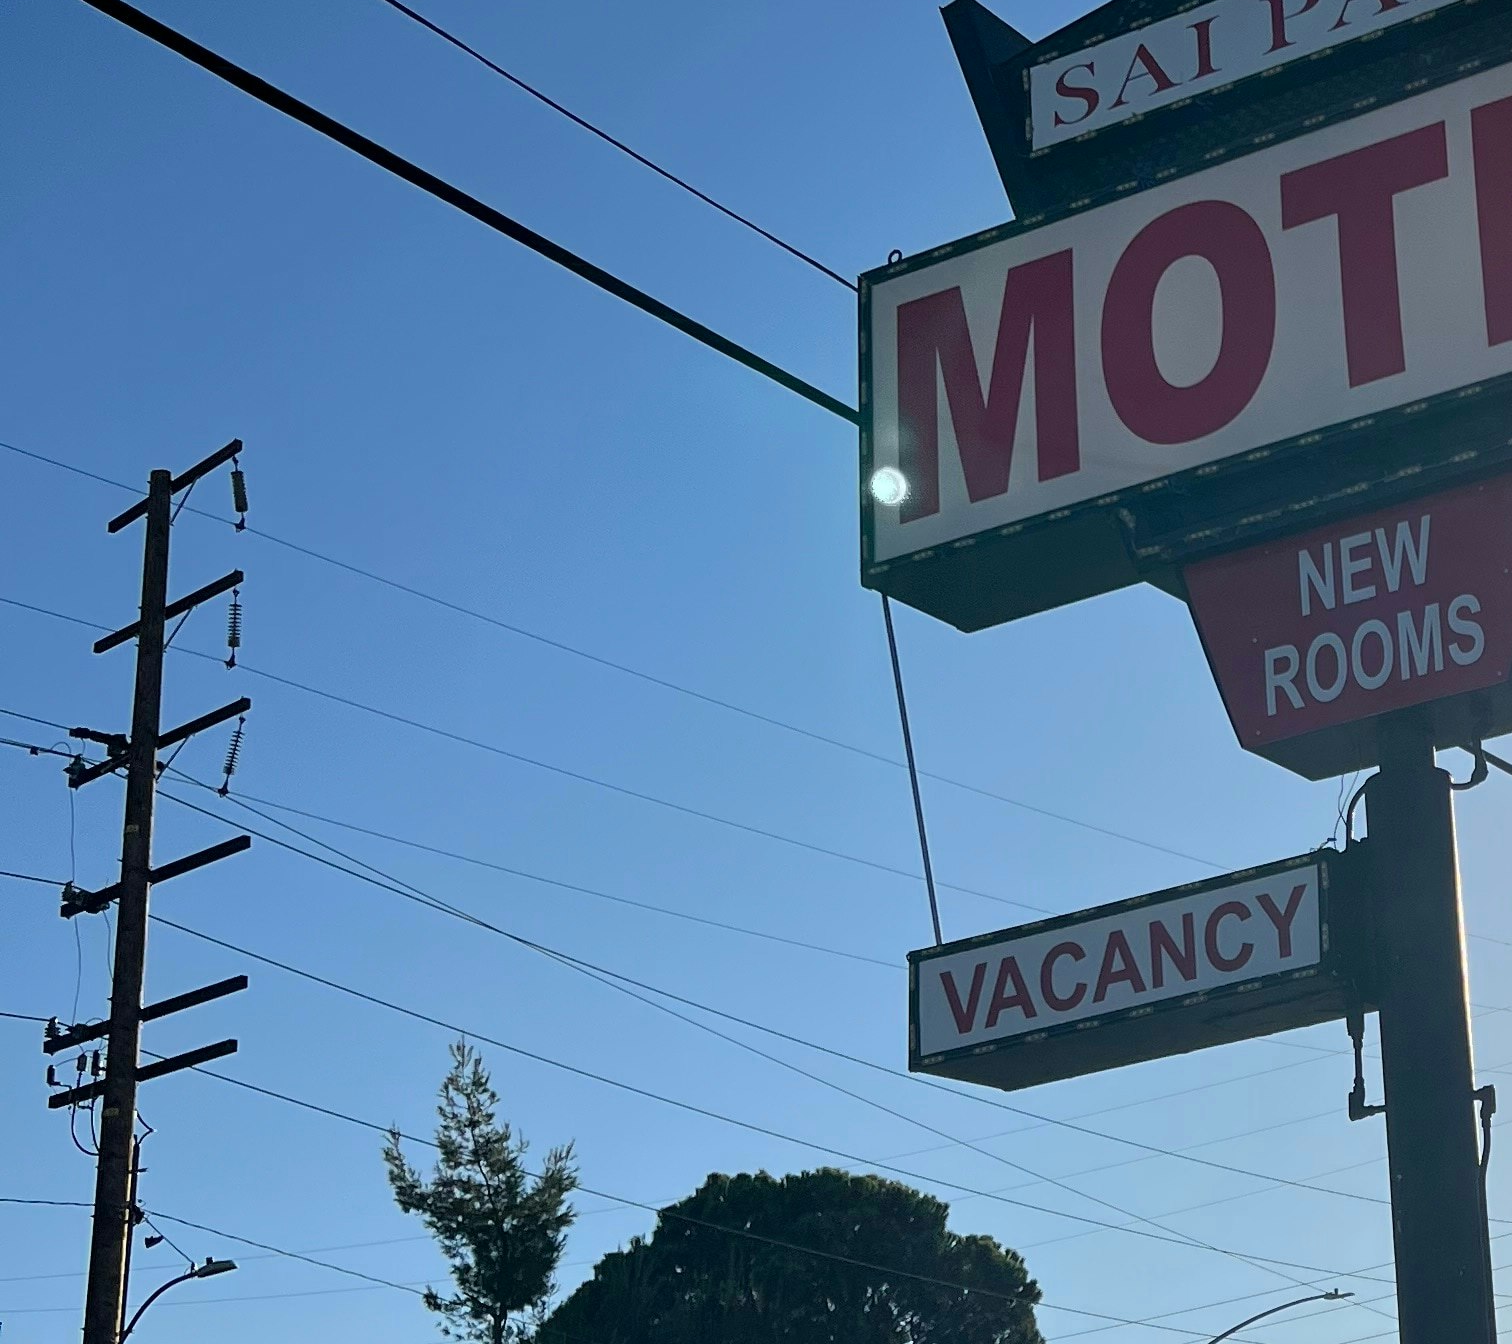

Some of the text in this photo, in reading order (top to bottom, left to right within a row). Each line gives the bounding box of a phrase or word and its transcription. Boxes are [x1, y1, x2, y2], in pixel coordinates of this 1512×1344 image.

[1054, 20, 1221, 129] SAI
[1297, 515, 1432, 617] NEW
[1264, 593, 1486, 717] ROOMS
[939, 884, 1307, 1035] VACANCY
